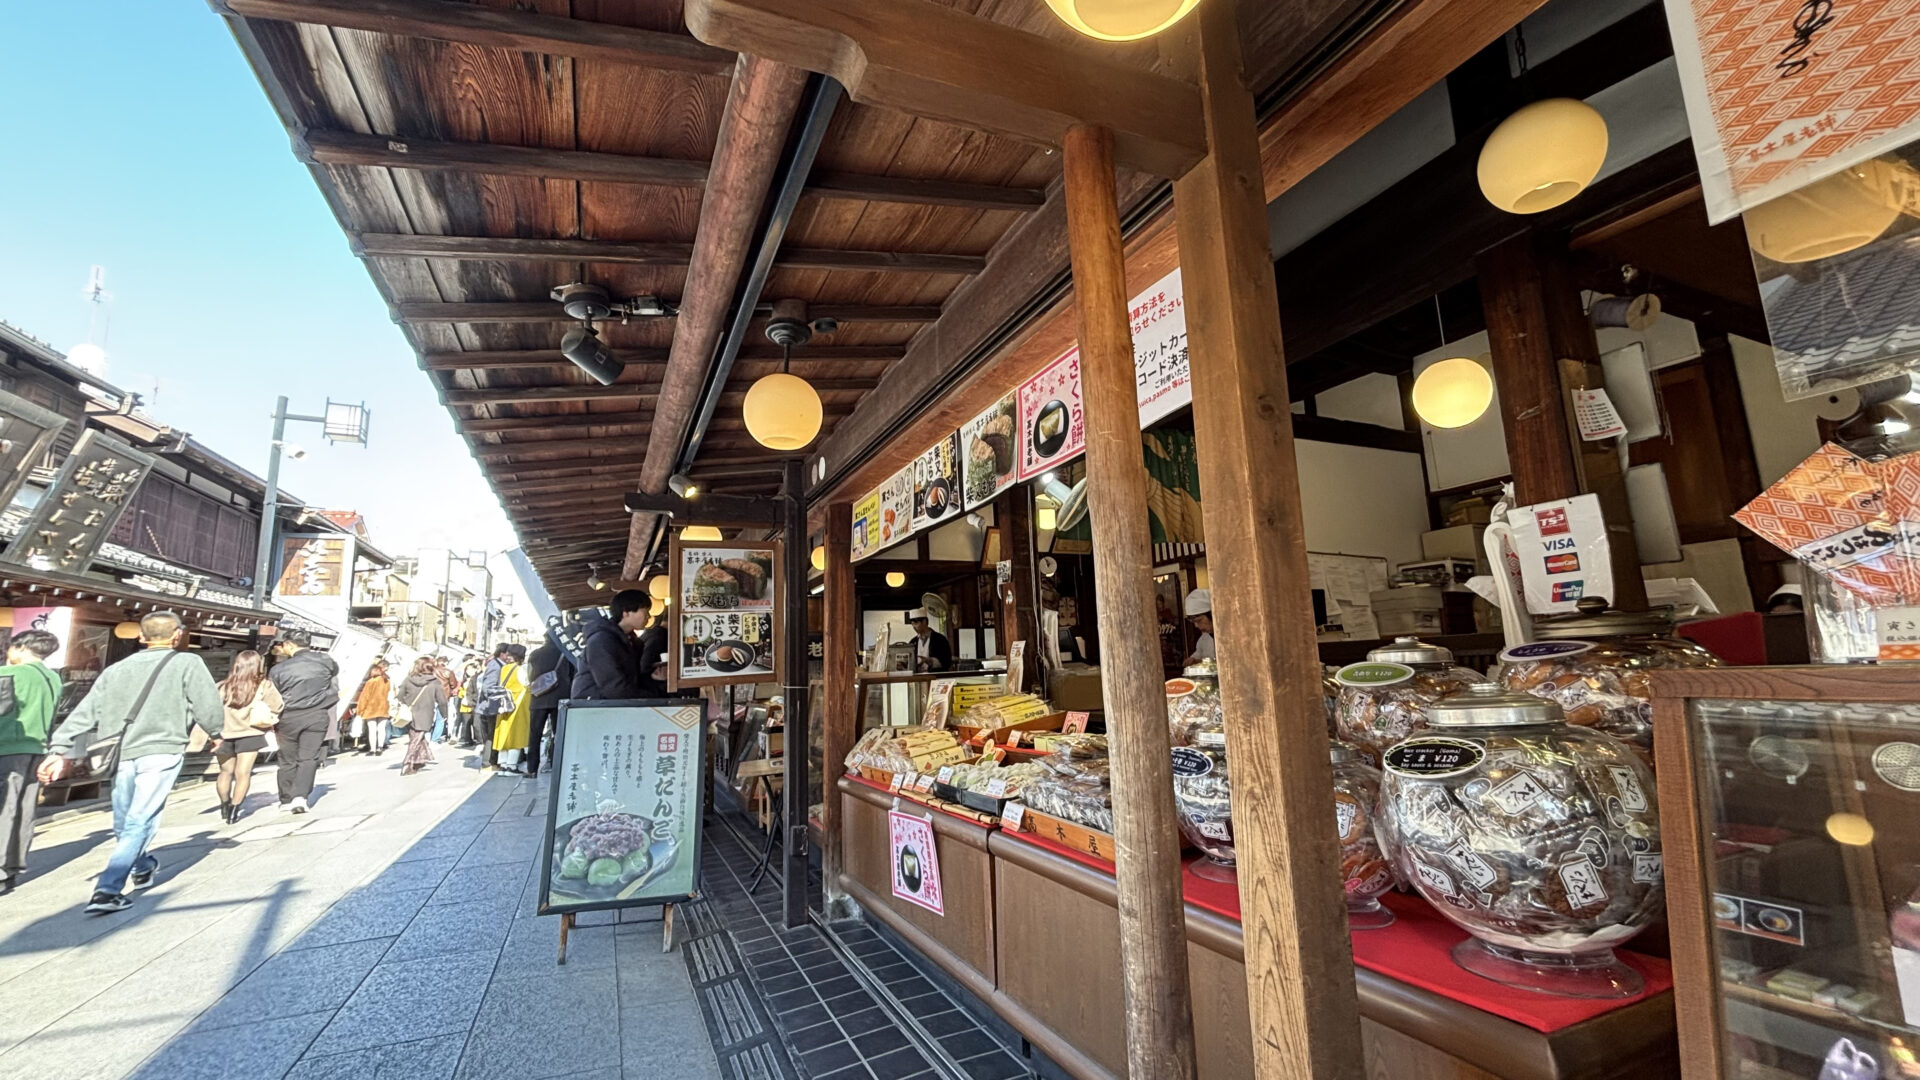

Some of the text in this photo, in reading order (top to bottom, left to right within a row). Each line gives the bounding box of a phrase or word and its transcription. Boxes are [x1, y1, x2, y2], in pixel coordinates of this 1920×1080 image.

[1746, 113, 1836, 162] 高木屋老舗
[1135, 333, 1187, 367] ジットカー
[1069, 359, 1085, 448] さくら餅
[1542, 538, 1576, 551] VISA
[685, 595, 740, 609] 柴又もち
[713, 615, 726, 647] ぶらり
[808, 642, 823, 657] 老
[1435, 755, 1459, 763] ¥120
[653, 755, 676, 840] 草だんご
[1027, 813, 1101, 857] 高木屋
